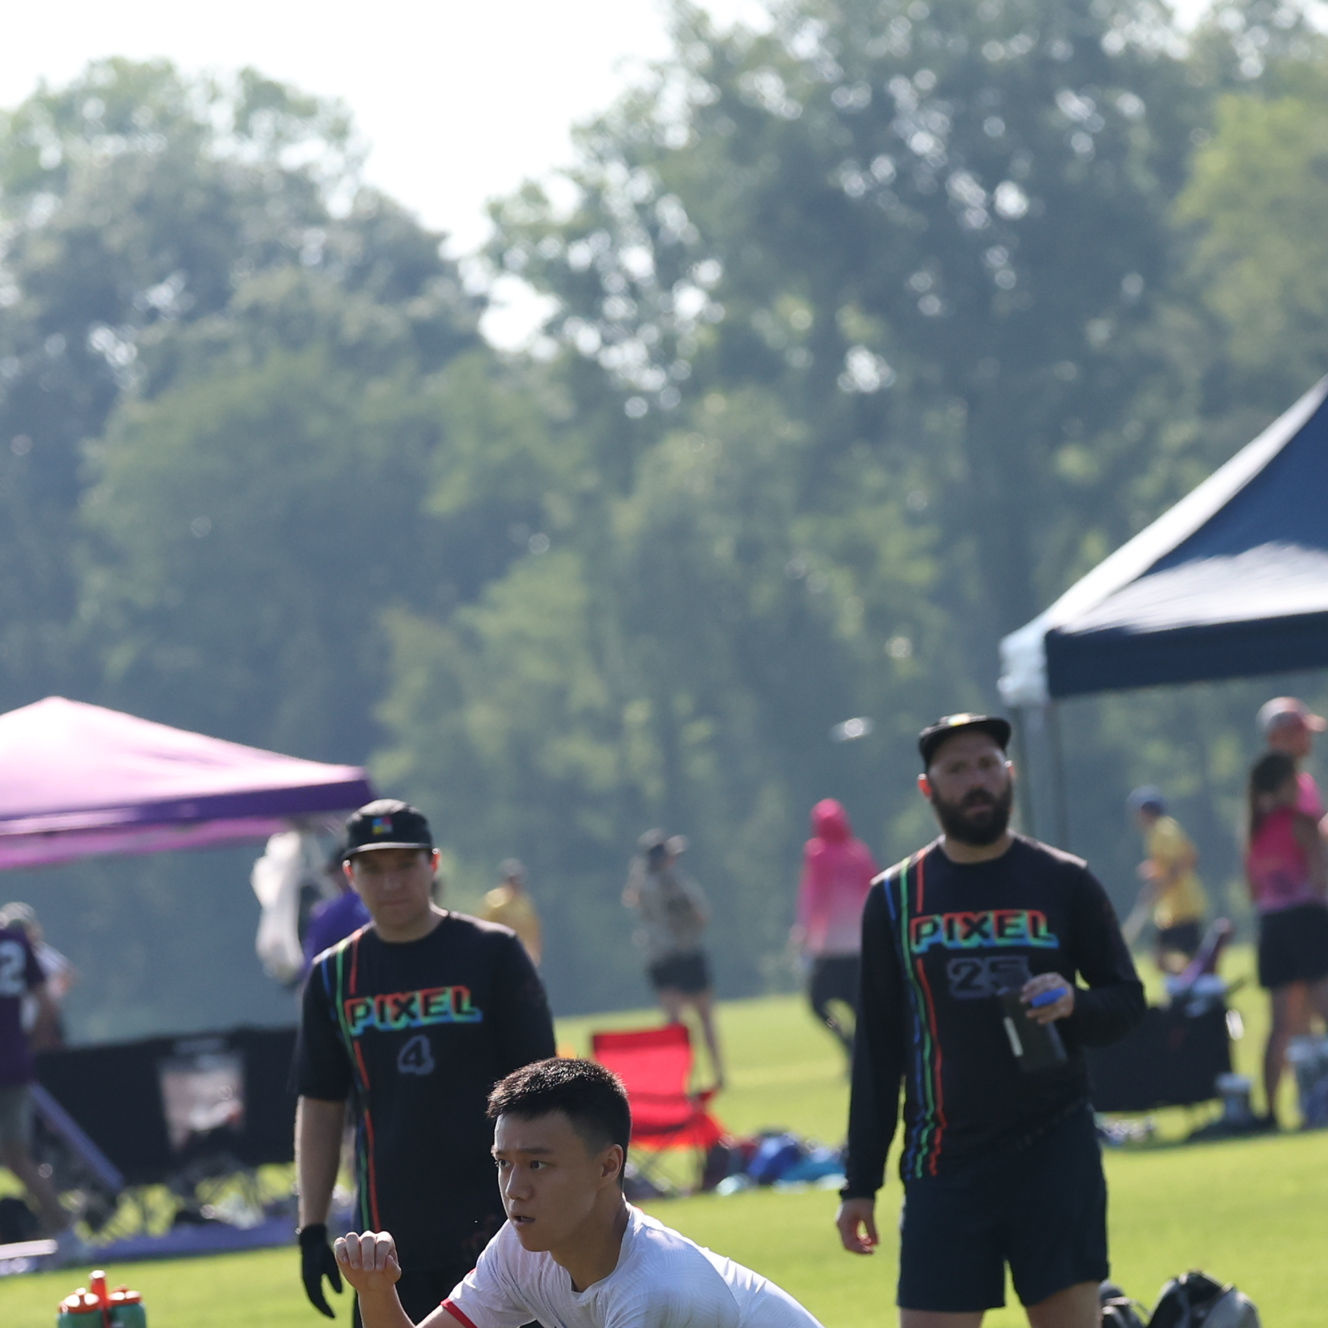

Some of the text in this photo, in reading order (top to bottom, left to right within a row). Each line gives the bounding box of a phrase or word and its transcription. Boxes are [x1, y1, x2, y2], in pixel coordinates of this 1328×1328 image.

[910, 909, 1059, 953] PIXEL
[344, 985, 483, 1036] PIXEL
[397, 1035, 435, 1075] 4
